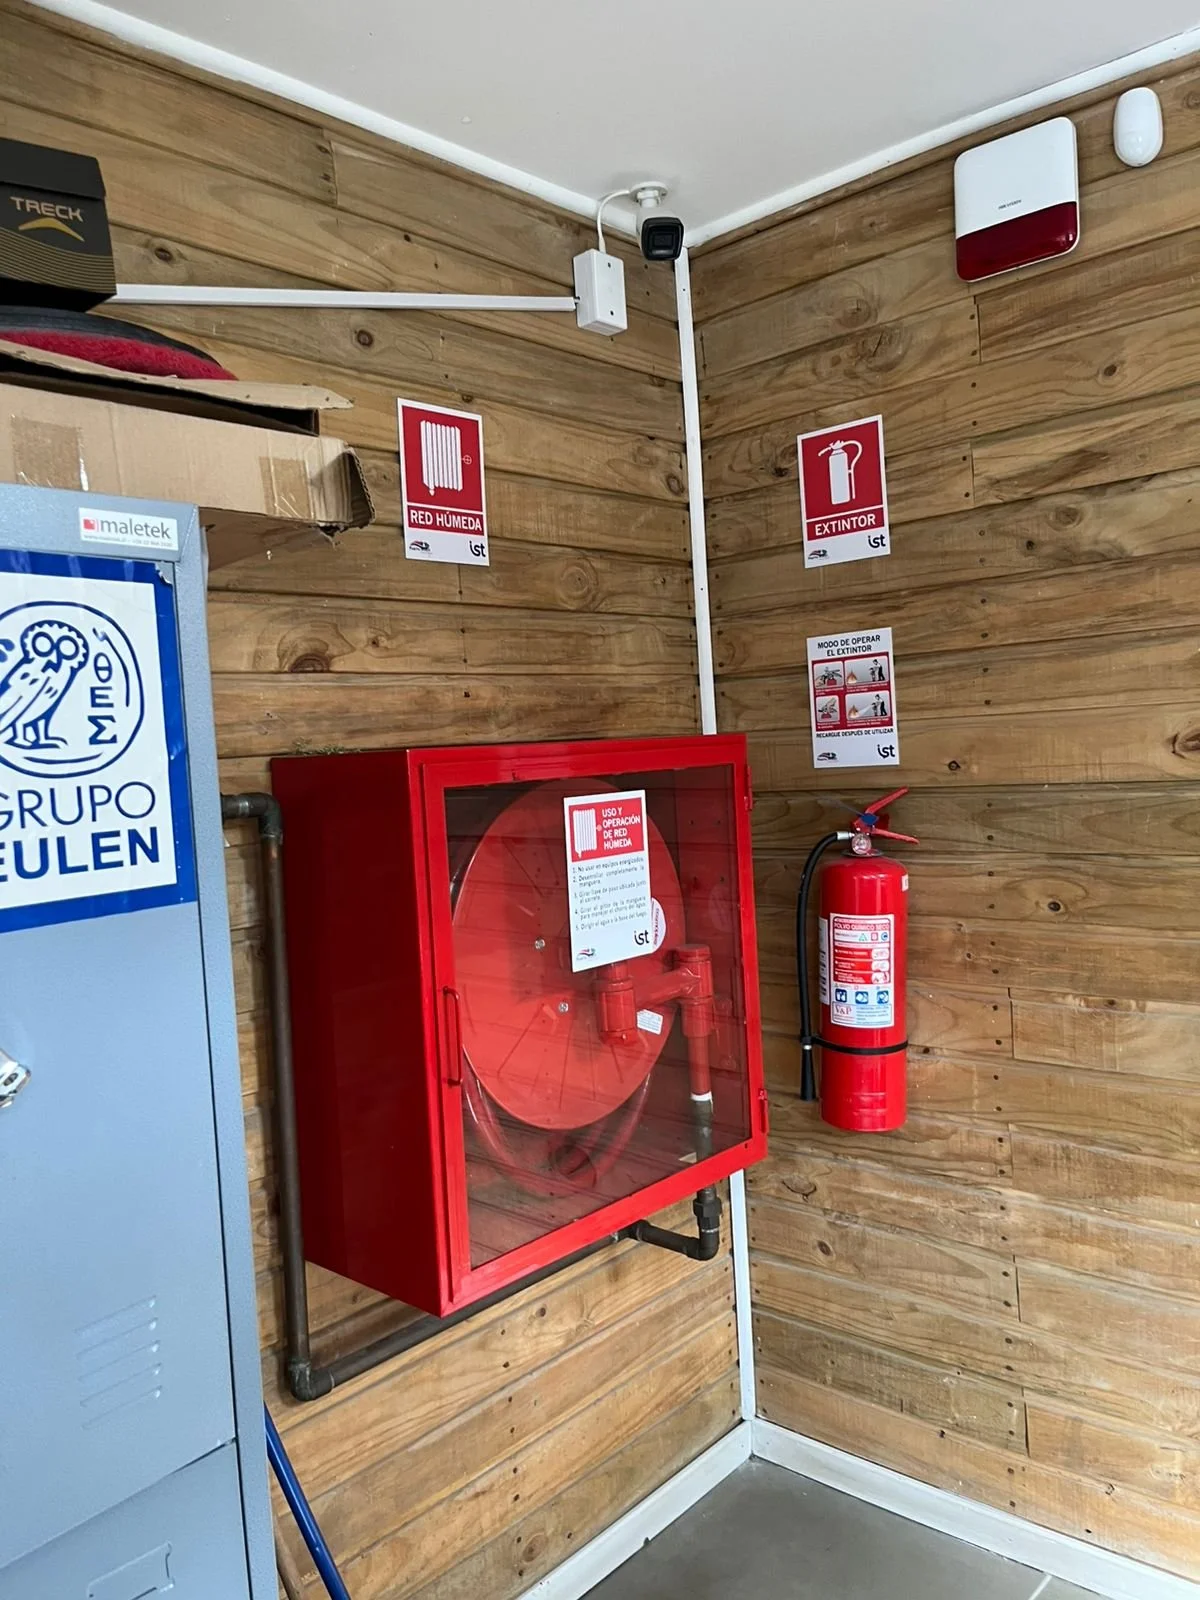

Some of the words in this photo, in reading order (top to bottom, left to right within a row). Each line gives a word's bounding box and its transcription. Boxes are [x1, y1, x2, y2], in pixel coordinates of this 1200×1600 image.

[10, 196, 84, 222] TRECK
[410, 510, 433, 525] RED
[436, 511, 482, 531] HÚMEDA
[815, 513, 876, 536] EXTINTOR
[101, 518, 171, 539] maletek
[470, 540, 486, 557] ist
[868, 534, 886, 548] ist
[818, 640, 838, 649] MODO
[841, 638, 849, 646] DE
[851, 634, 880, 645] OPERAR
[837, 645, 872, 656] EXTINTOR
[877, 744, 895, 758] ist
[602, 808, 617, 817] USO
[618, 807, 622, 816] Y
[602, 814, 640, 828] OPERACIÓN
[603, 830, 613, 839] DE
[614, 828, 627, 837] RED
[634, 930, 650, 946] ist
